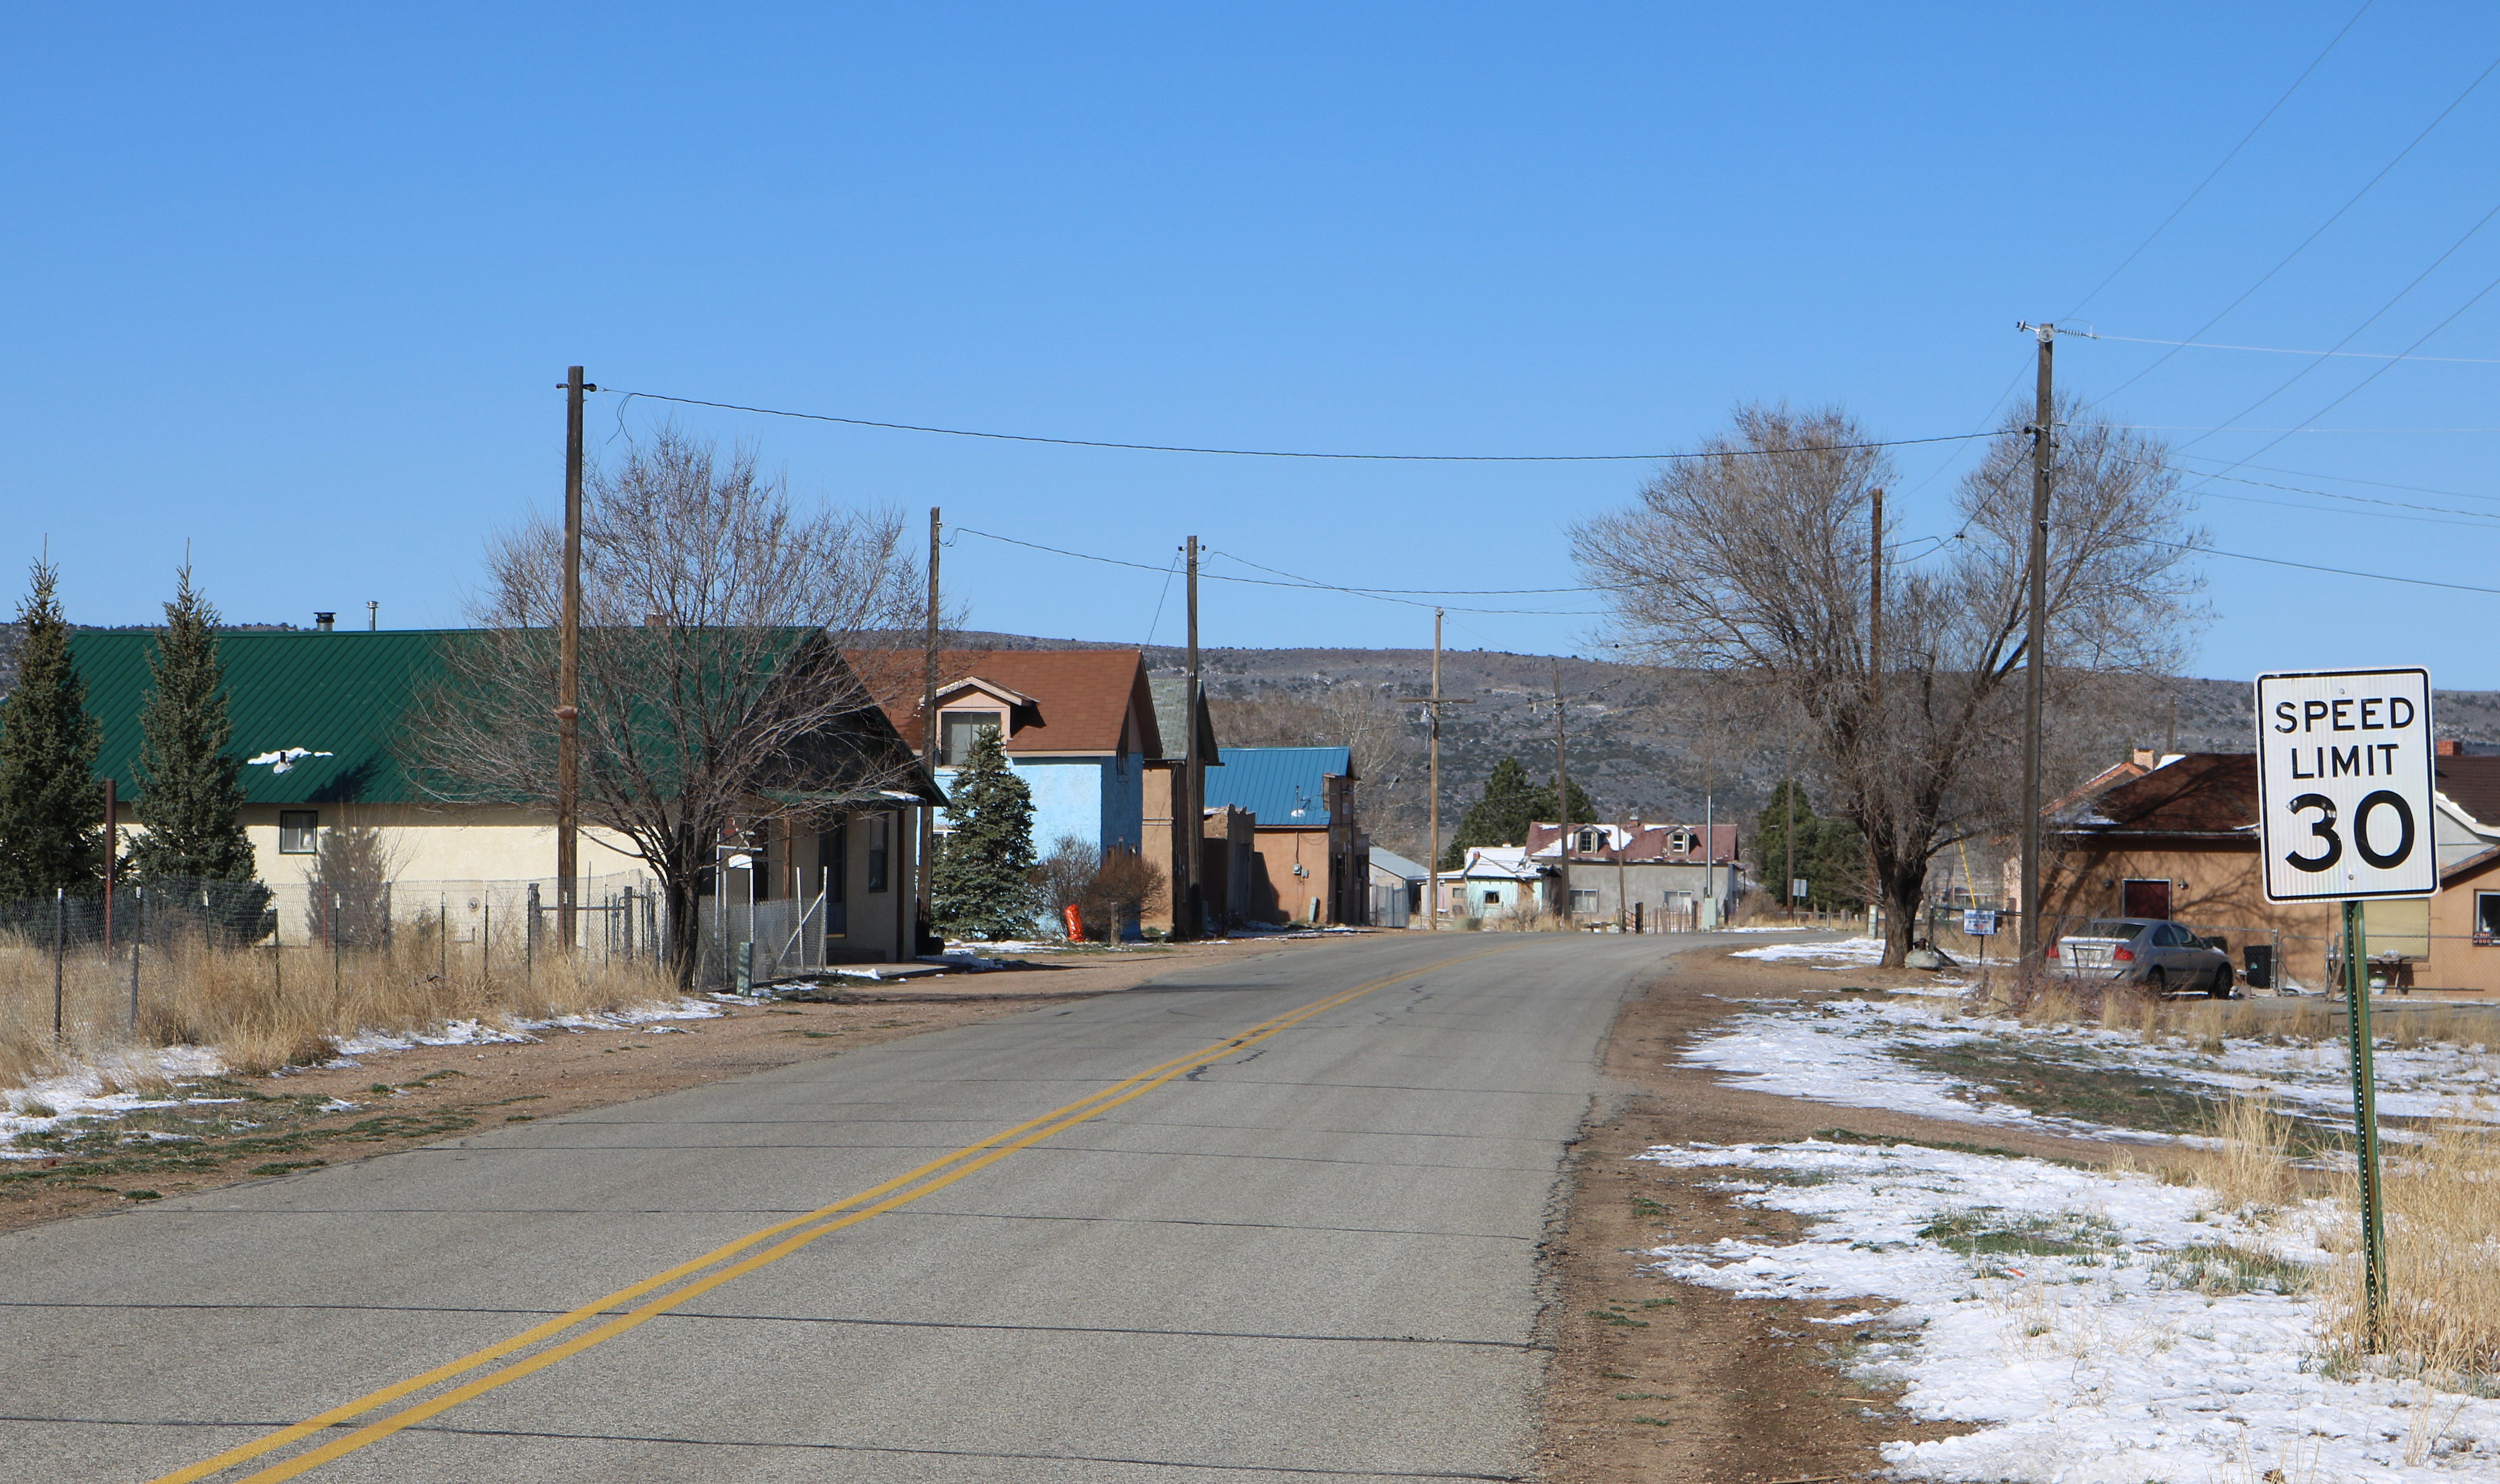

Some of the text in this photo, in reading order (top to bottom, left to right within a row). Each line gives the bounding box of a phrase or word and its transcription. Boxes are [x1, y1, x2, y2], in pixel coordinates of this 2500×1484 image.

[2274, 697, 2414, 734] SPEED
[2291, 744, 2399, 780] LIMIT
[2285, 790, 2415, 873] 30
